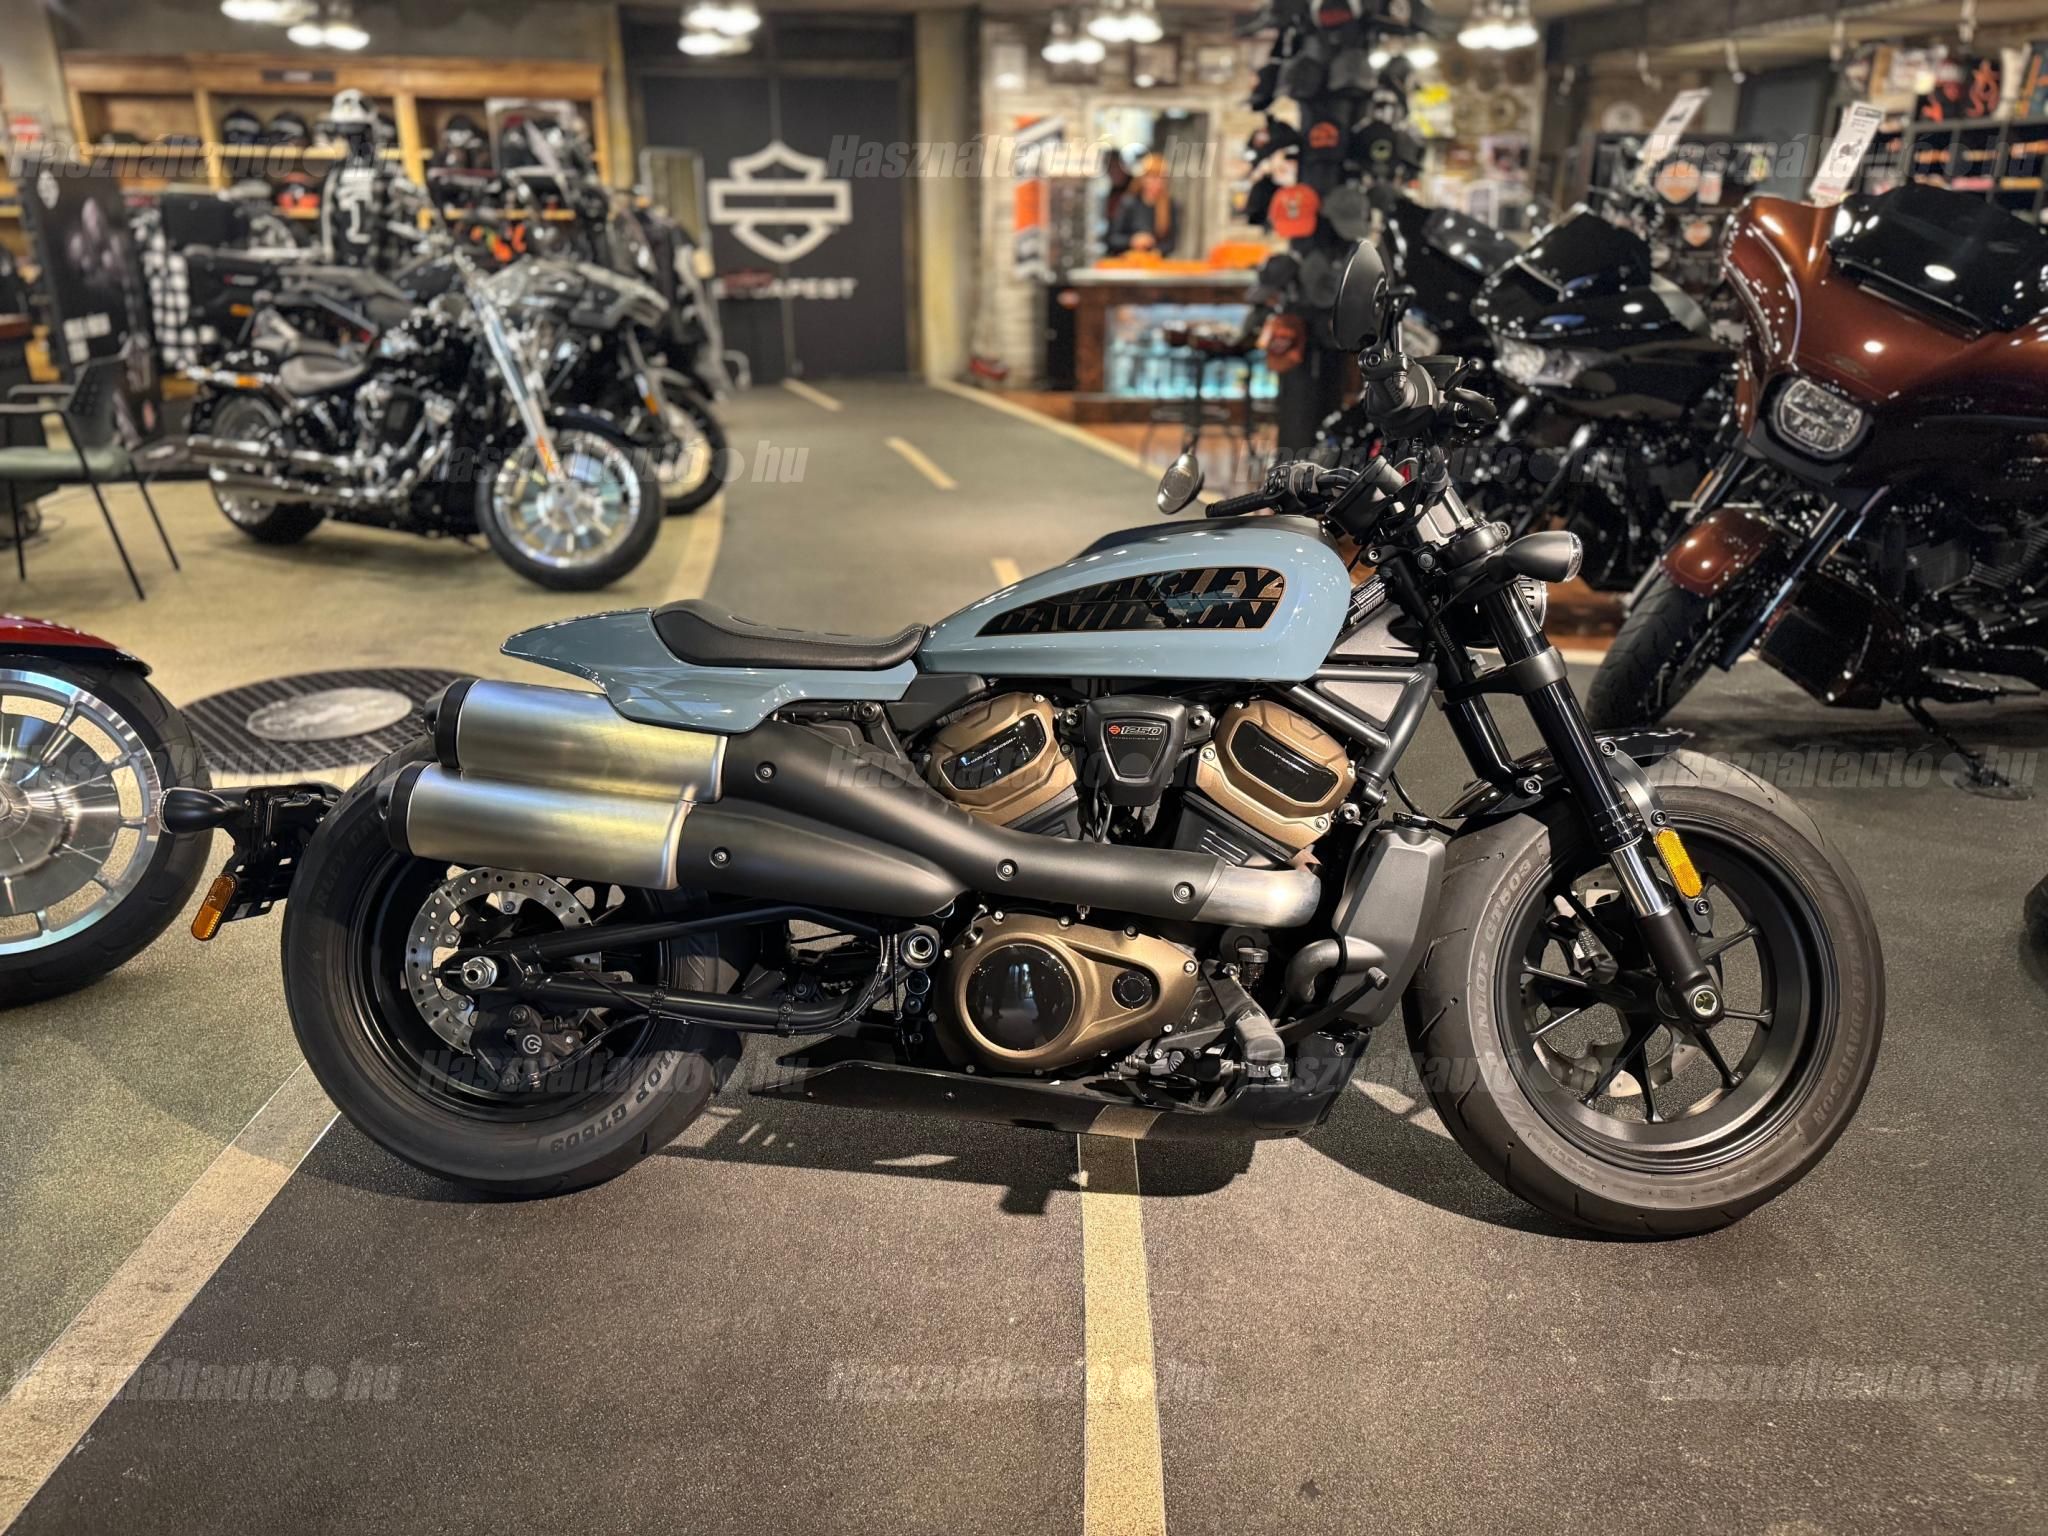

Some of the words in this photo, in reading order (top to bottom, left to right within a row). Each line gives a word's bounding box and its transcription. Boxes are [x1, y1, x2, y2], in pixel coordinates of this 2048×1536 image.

[1120, 726, 1162, 736] 1250
[1485, 858, 1532, 943] GT603
[550, 1103, 627, 1151] GT603
